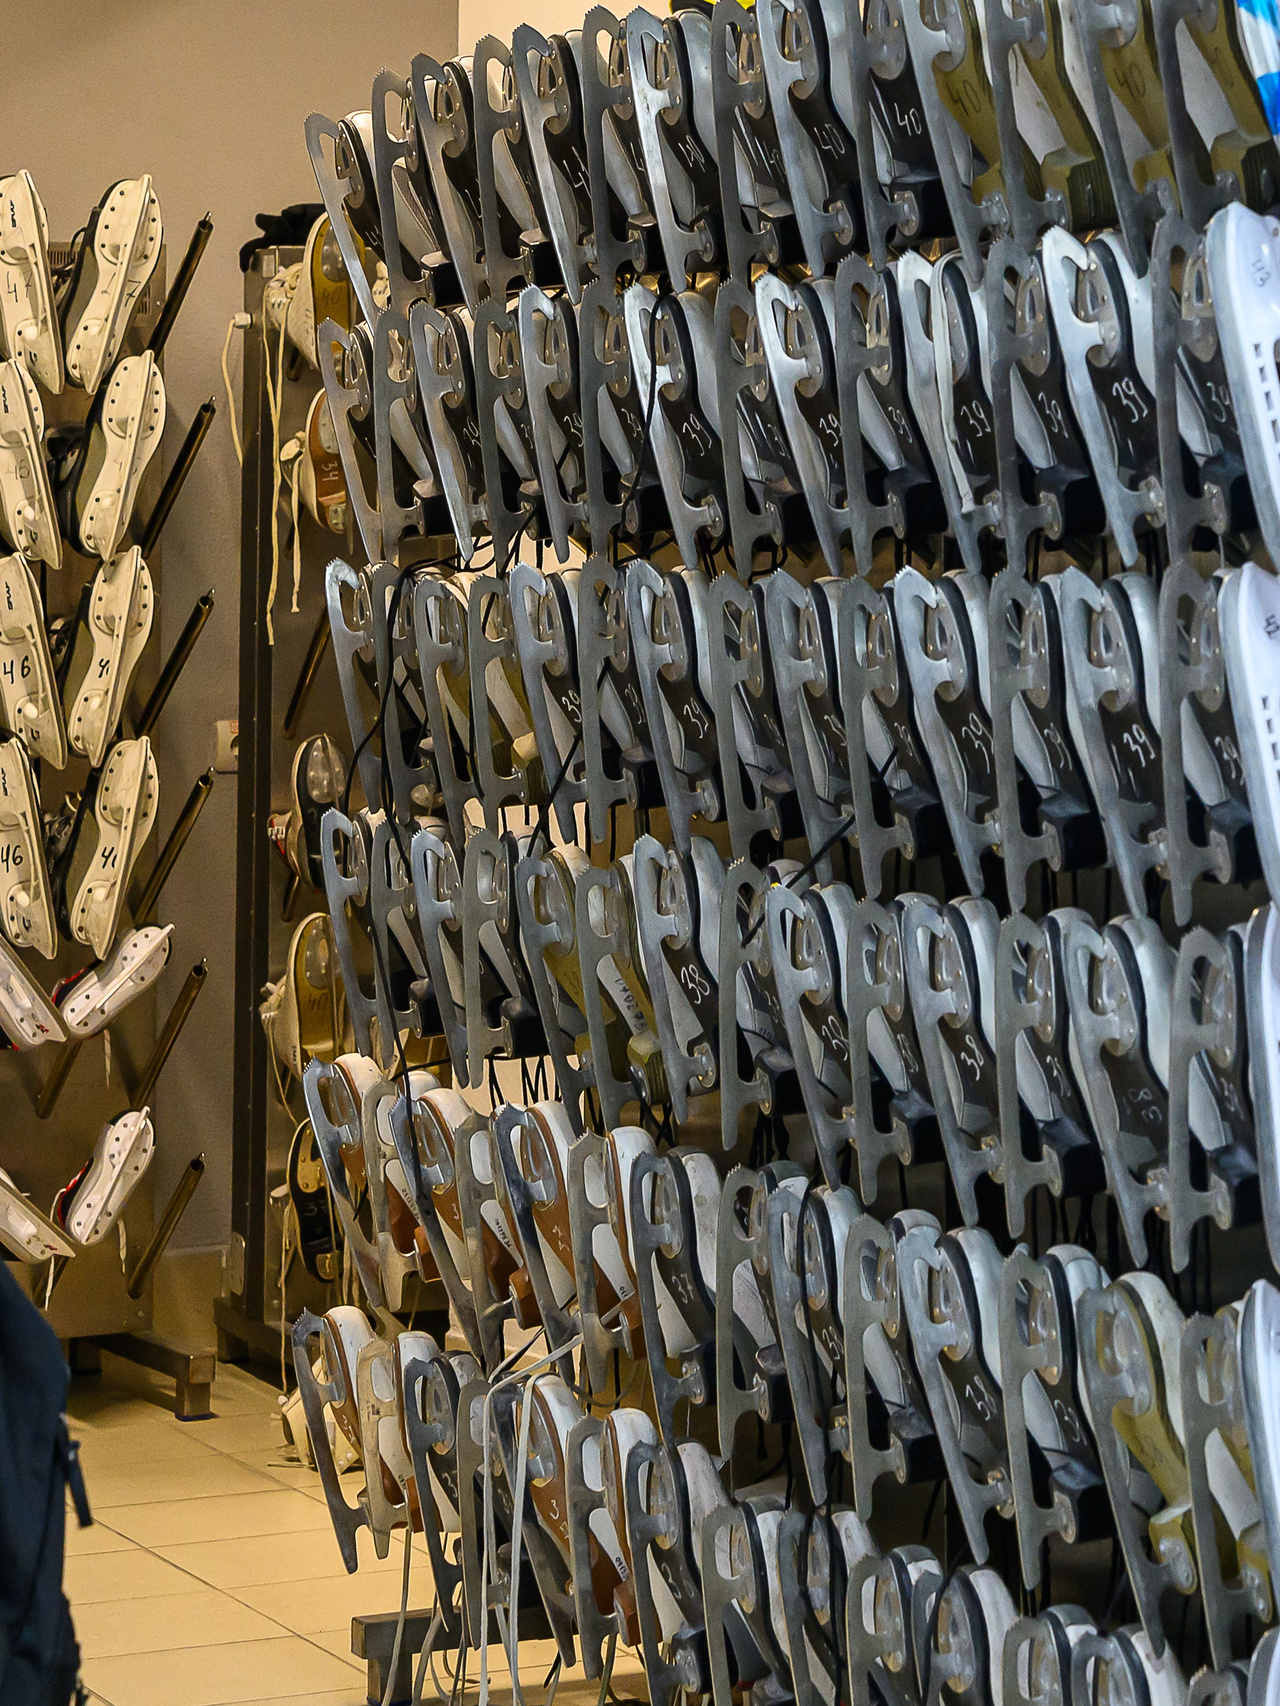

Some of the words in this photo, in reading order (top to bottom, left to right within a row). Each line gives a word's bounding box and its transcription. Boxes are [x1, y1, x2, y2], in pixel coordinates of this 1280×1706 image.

[949, 80, 981, 116] 40
[1113, 62, 1145, 99] 40
[894, 102, 922, 136] 40
[814, 123, 846, 160] 40
[1250, 258, 1271, 288] 43
[960, 400, 991, 437] 39
[1038, 391, 1069, 439] 39
[1112, 377, 1148, 423] 39
[683, 413, 712, 455] 39
[819, 413, 842, 446] 39
[322, 461, 338, 482] 34
[3, 656, 31, 684] 46
[683, 698, 709, 739] 39
[962, 712, 994, 774] 39
[1123, 724, 1155, 767] 39
[1, 845, 24, 873] 46
[680, 964, 710, 1004] 38
[960, 1035, 985, 1081] 38
[671, 1273, 694, 1304] 37
